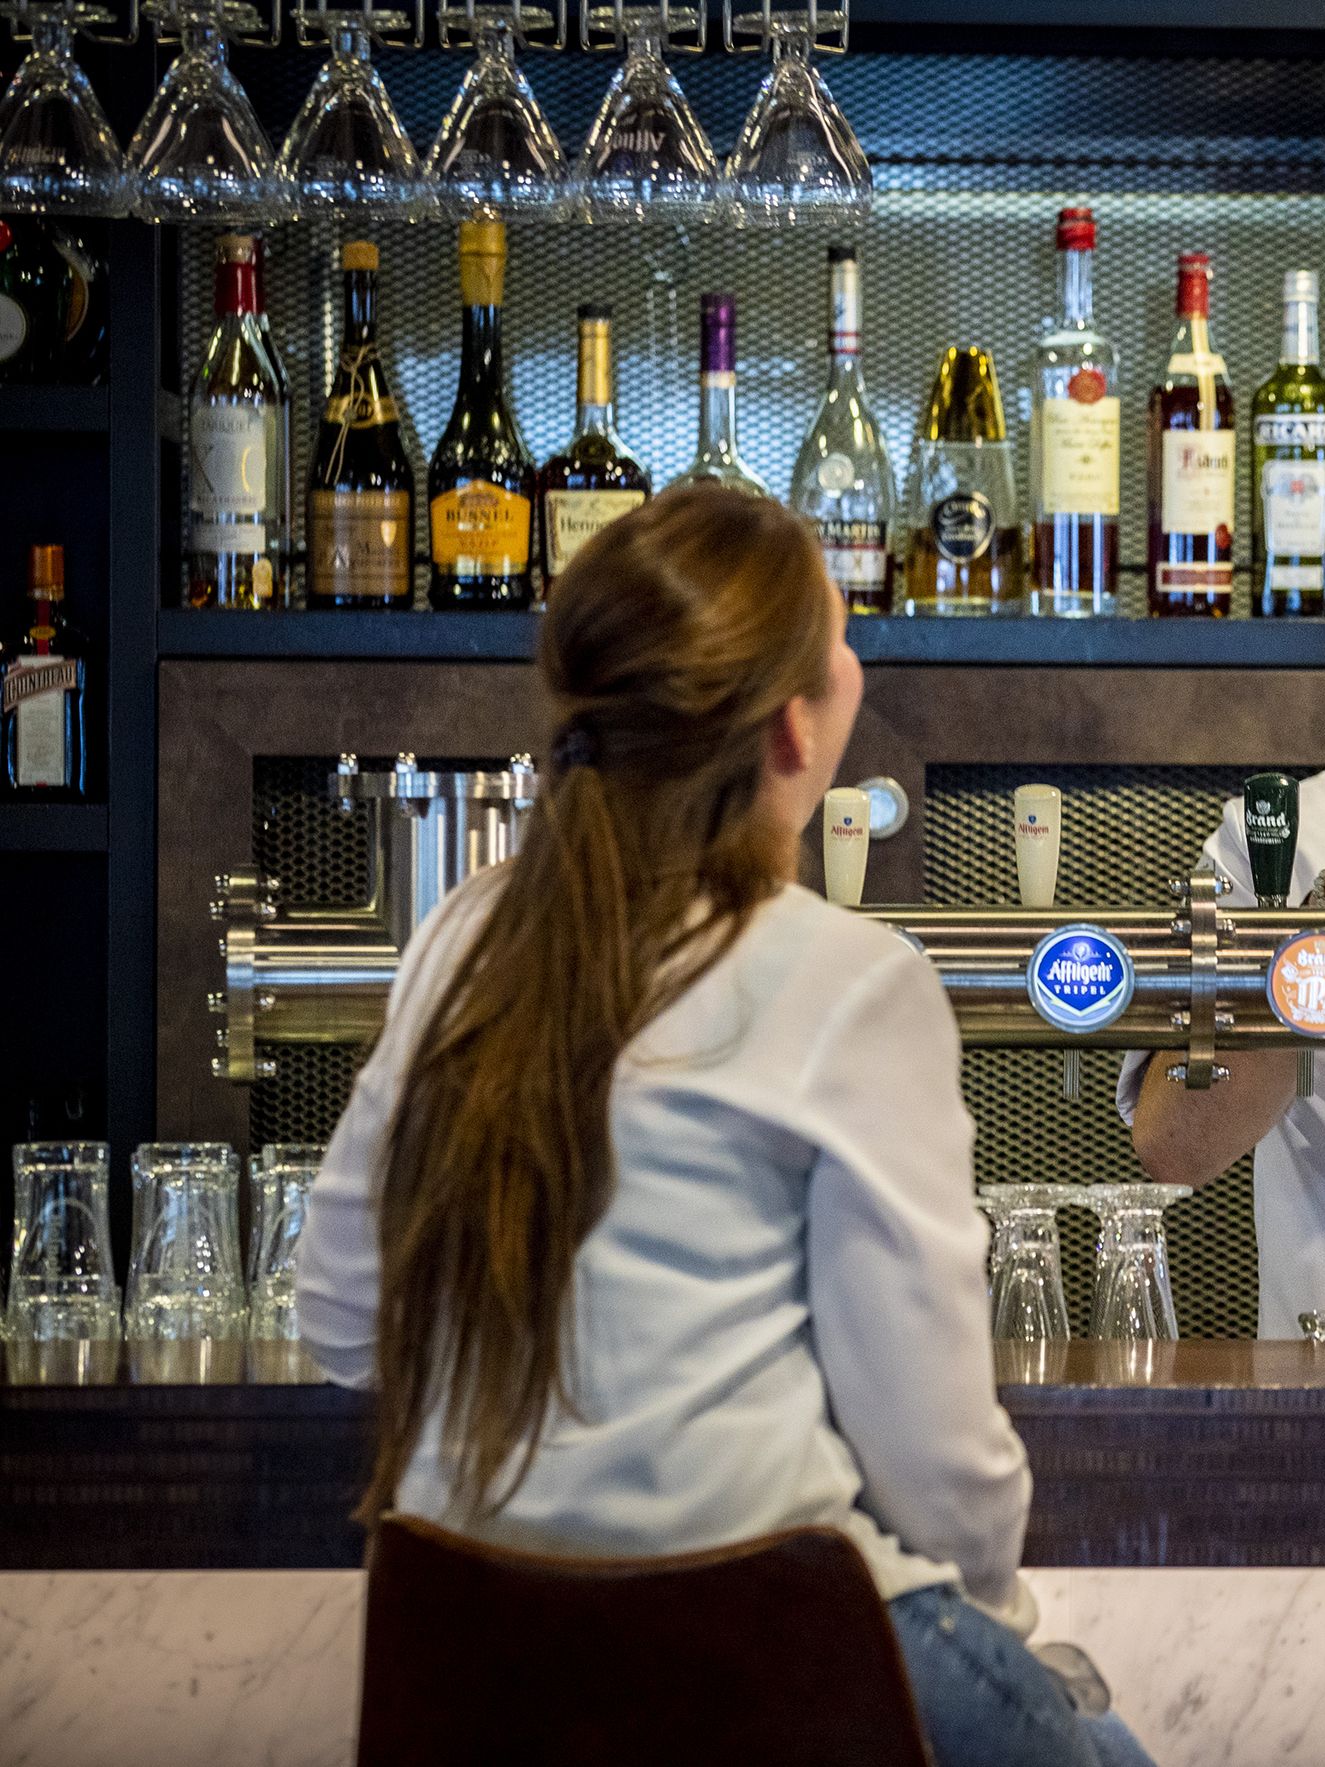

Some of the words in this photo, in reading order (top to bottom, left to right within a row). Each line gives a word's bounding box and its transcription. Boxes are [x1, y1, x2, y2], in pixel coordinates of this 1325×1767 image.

[1246, 808, 1287, 828] Brand
[1046, 959, 1113, 985] Affligem
[1054, 984, 1106, 995] TRIPEL
